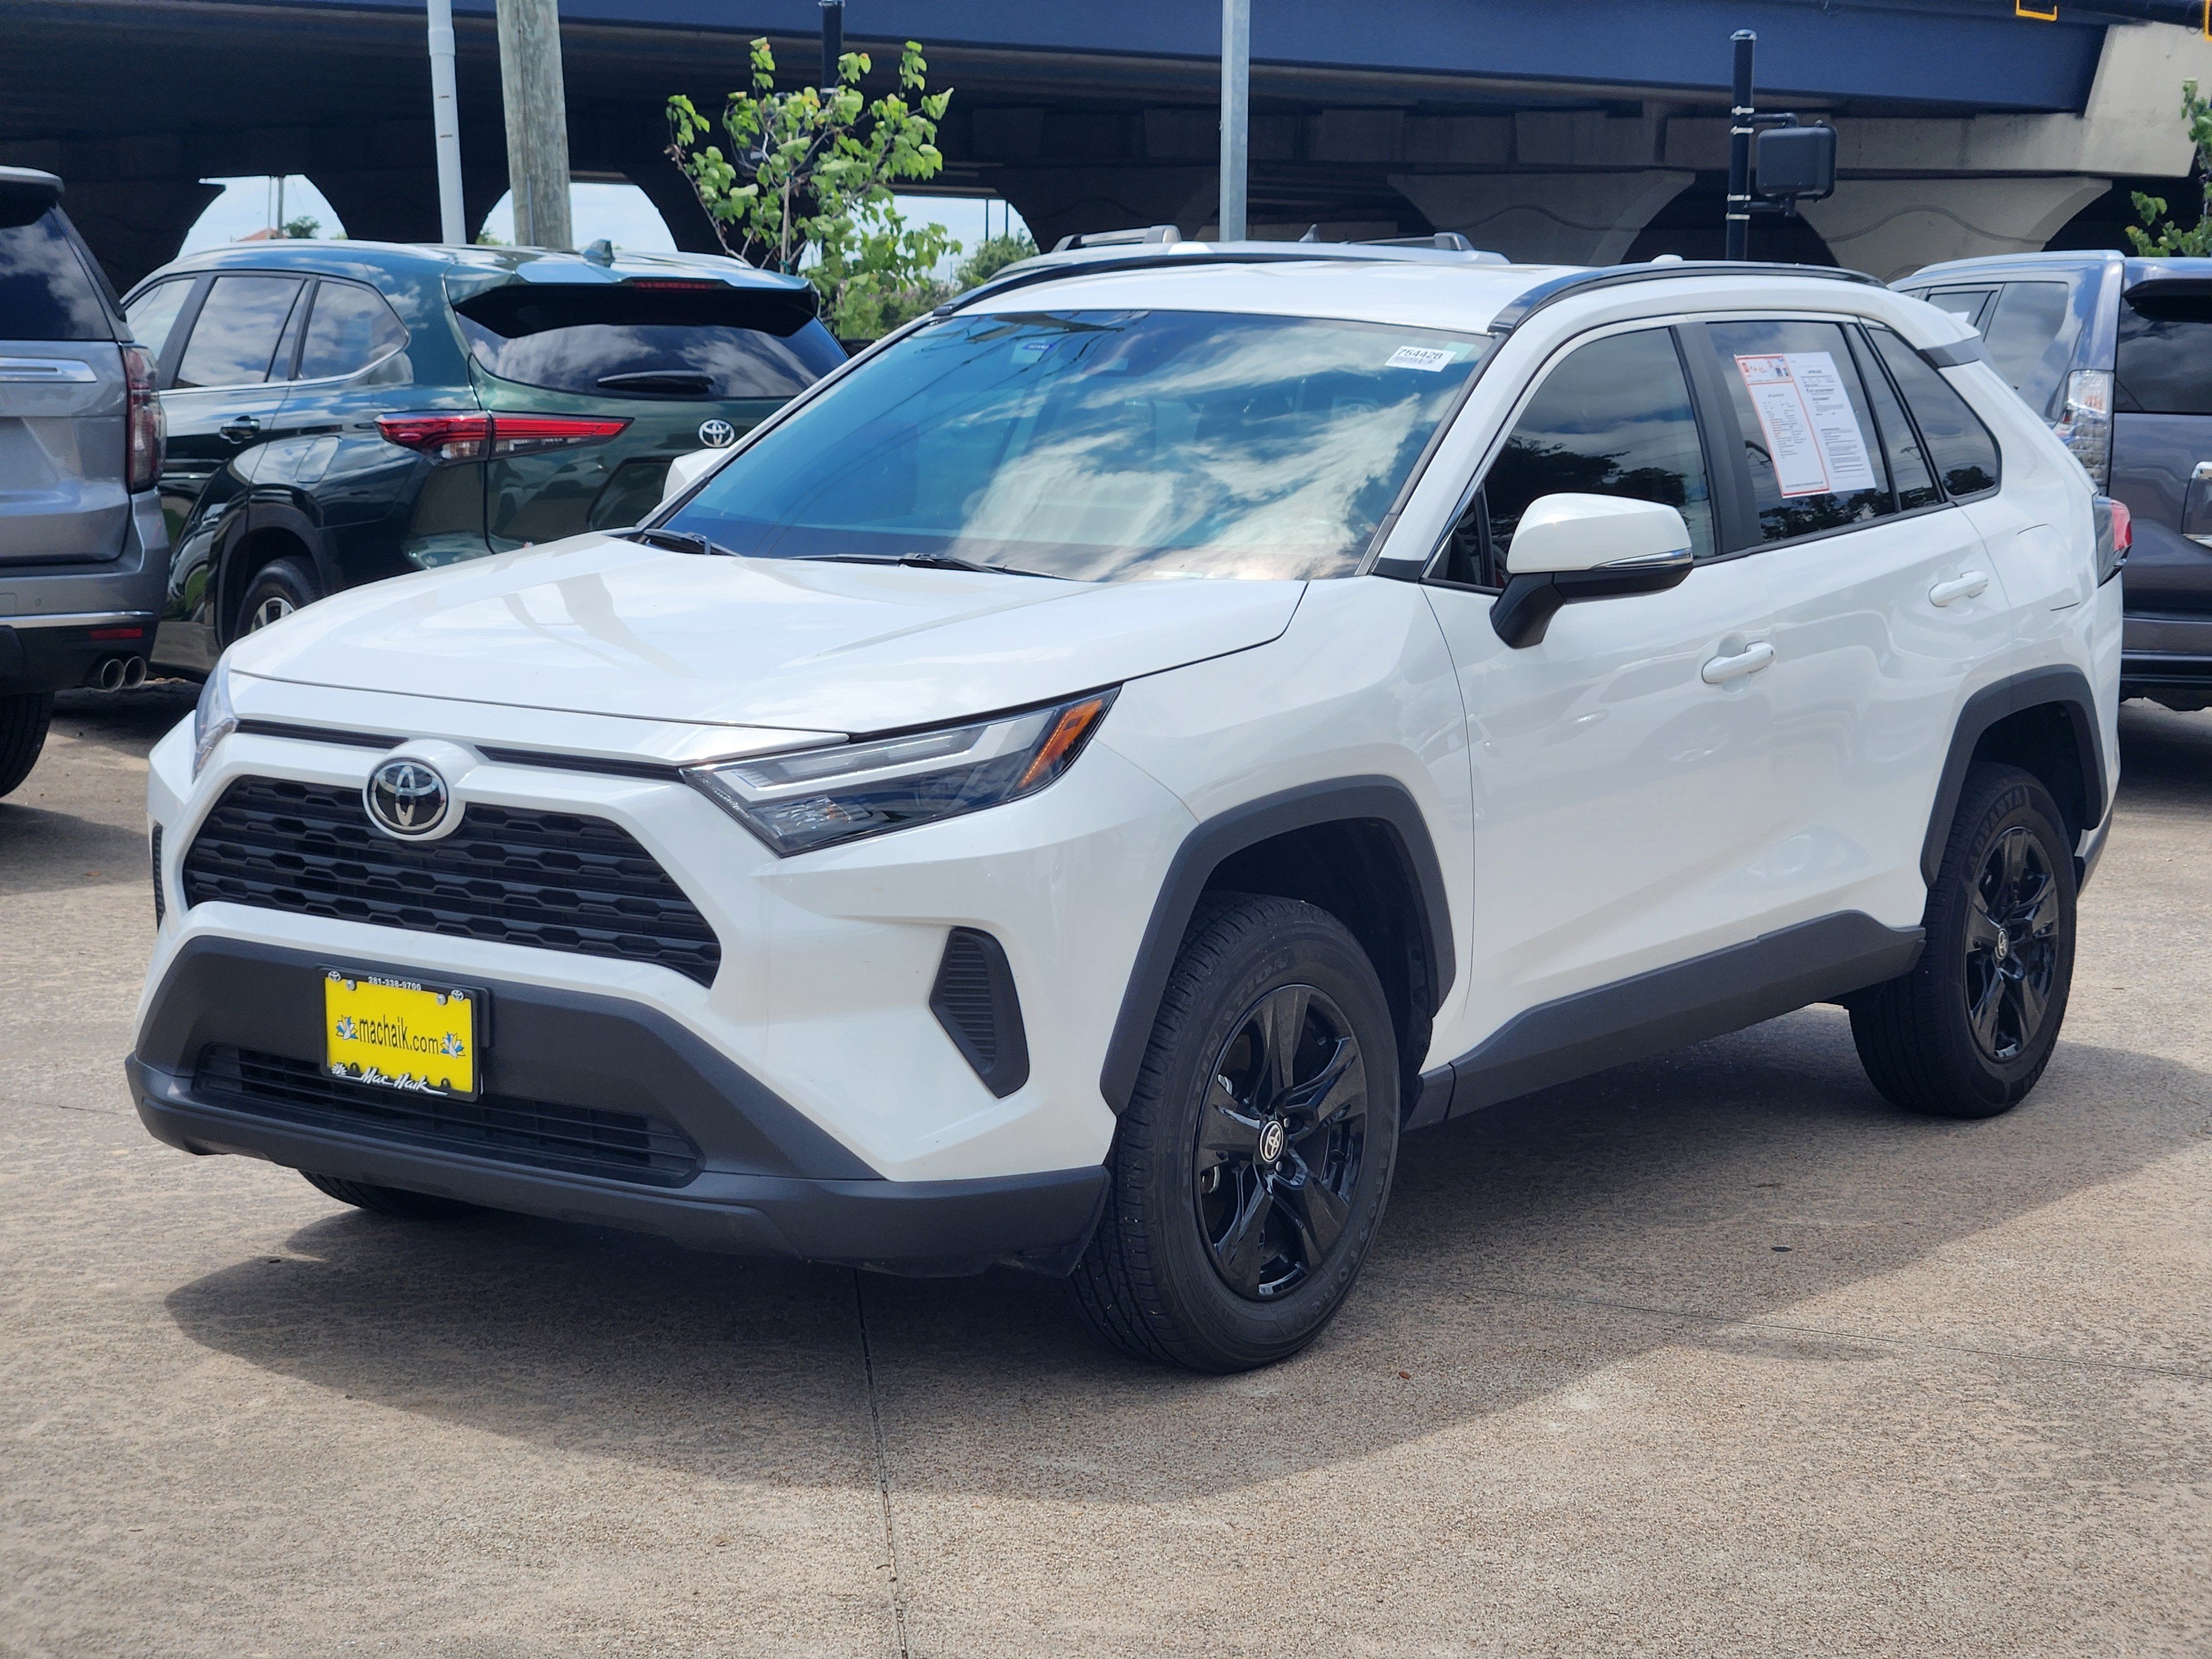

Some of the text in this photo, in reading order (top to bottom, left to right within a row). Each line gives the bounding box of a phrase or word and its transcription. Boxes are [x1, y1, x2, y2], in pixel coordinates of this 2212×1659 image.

[368, 977, 421, 990] 281-338-9700
[359, 1014, 439, 1055] machaik.com
[361, 1068, 429, 1091] Mac Haik
